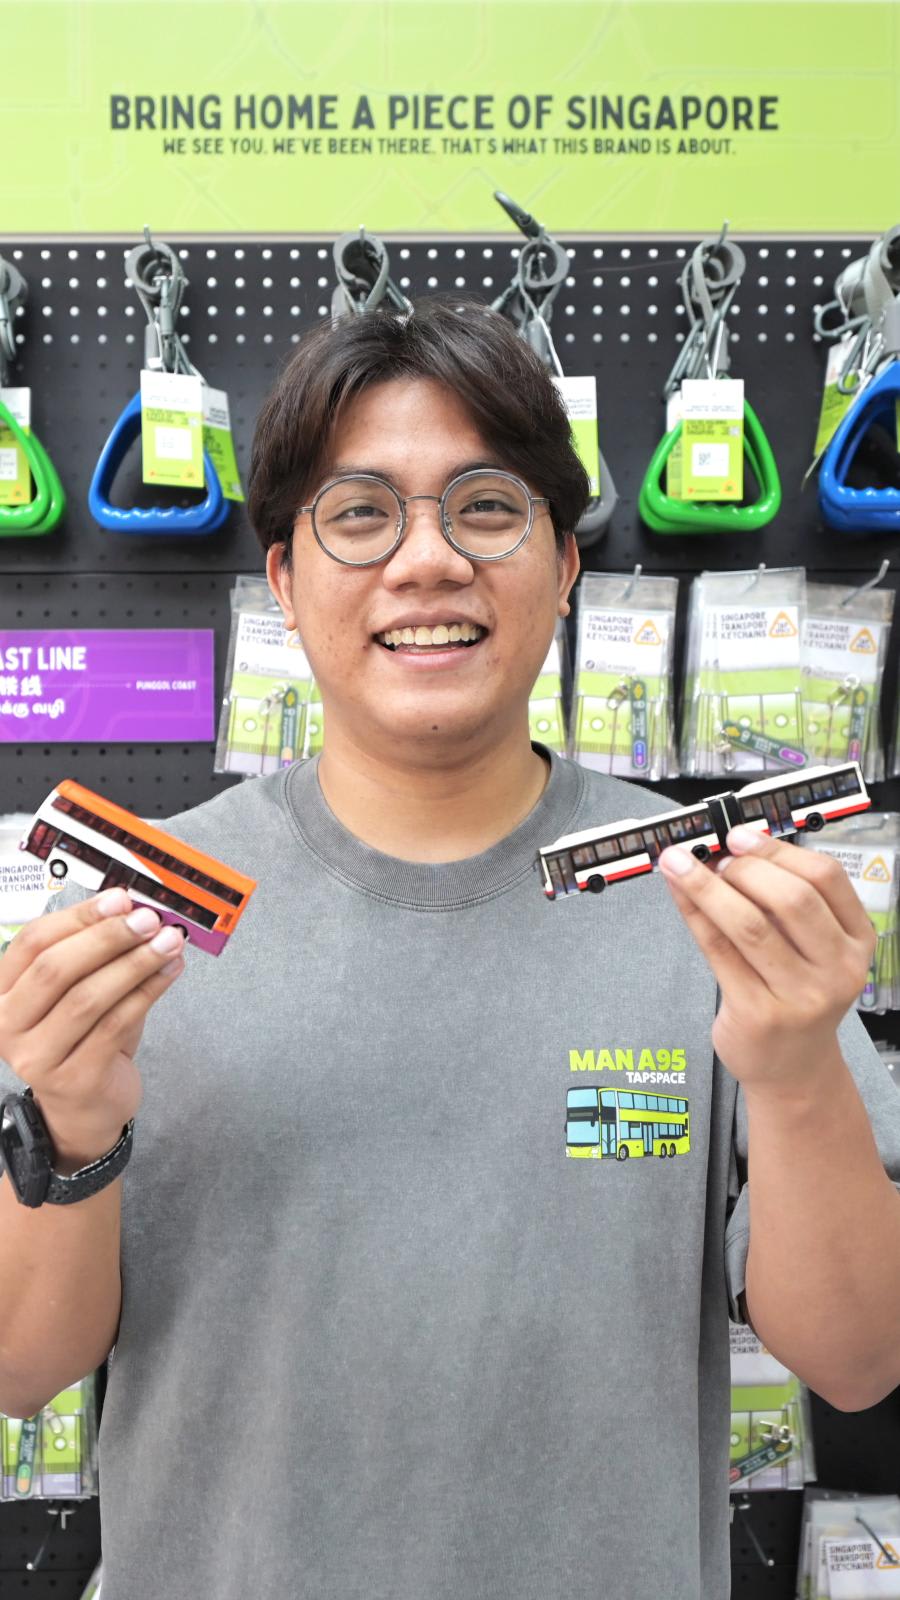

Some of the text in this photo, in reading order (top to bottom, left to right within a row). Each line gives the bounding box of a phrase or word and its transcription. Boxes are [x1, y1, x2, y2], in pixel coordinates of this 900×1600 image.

[110, 95, 780, 131] BRING HOME A PIECE OF SINGAPORE
[163, 138, 187, 154] WE
[193, 138, 223, 154] SEE
[230, 138, 267, 154] YOU.
[273, 138, 322, 154] WE'VE
[328, 138, 373, 154] BEEN
[442, 138, 497, 154] THAT'S
[502, 138, 547, 154] WHAT
[553, 138, 588, 154] THIS
[594, 138, 651, 154] BRAND
[656, 138, 671, 154] IS
[677, 138, 737, 154] ABOUT.
[588, 614, 633, 626] SINGAPORE
[720, 611, 767, 623] SINGAPORE
[587, 622, 634, 635] TRANSPORT
[720, 620, 768, 631] TRANSPORT
[586, 632, 632, 644] KEYCHAINS
[720, 630, 767, 640] KEYCHAINS
[37, 646, 87, 670] LINE
[136, 680, 197, 691] PUNGGOL COAST
[568, 1048, 687, 1072] MAN A95
[626, 1072, 686, 1084] TAPSPACE
[829, 1544, 872, 1554] SINGAPORE
